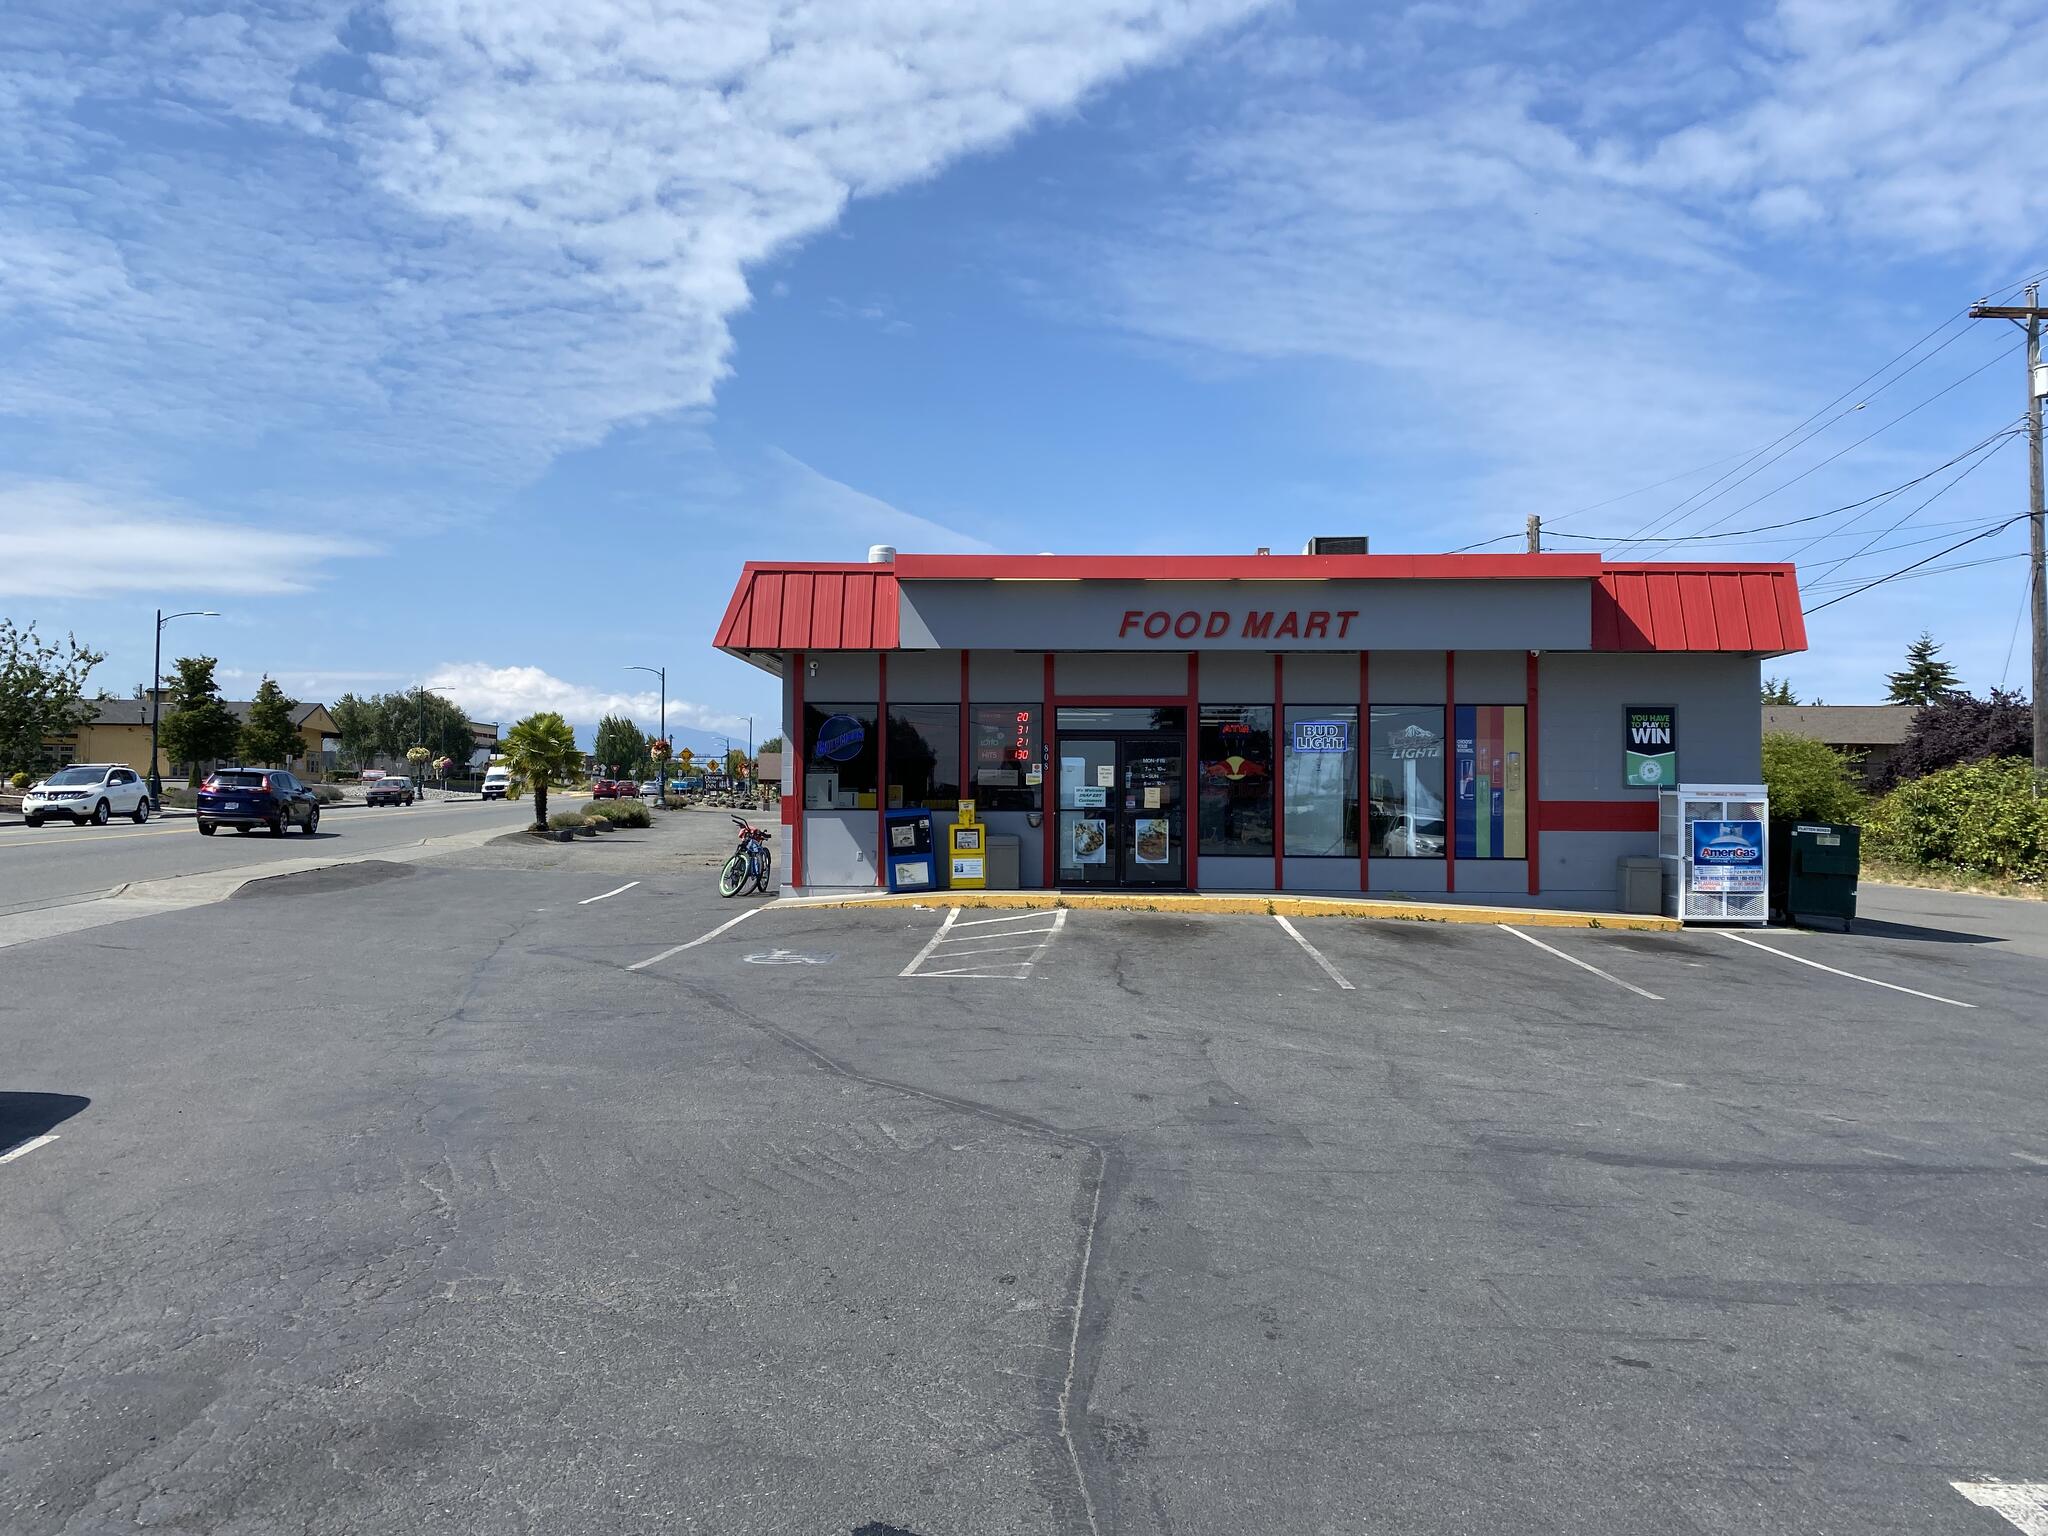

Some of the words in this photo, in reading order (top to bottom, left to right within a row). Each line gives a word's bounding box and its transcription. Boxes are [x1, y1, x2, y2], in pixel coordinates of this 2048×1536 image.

[1118, 611, 1230, 638] FOOD
[1241, 611, 1359, 638] MART
[1017, 712, 1028, 721] 20
[1017, 726, 1028, 734] 31
[1304, 725, 1338, 736] BUD
[1632, 728, 1670, 744] WIN
[1017, 738, 1028, 746] 21
[1297, 737, 1344, 748] LIGHT
[1014, 750, 1028, 760] 130
[1702, 848, 1756, 856] AmeriGas
